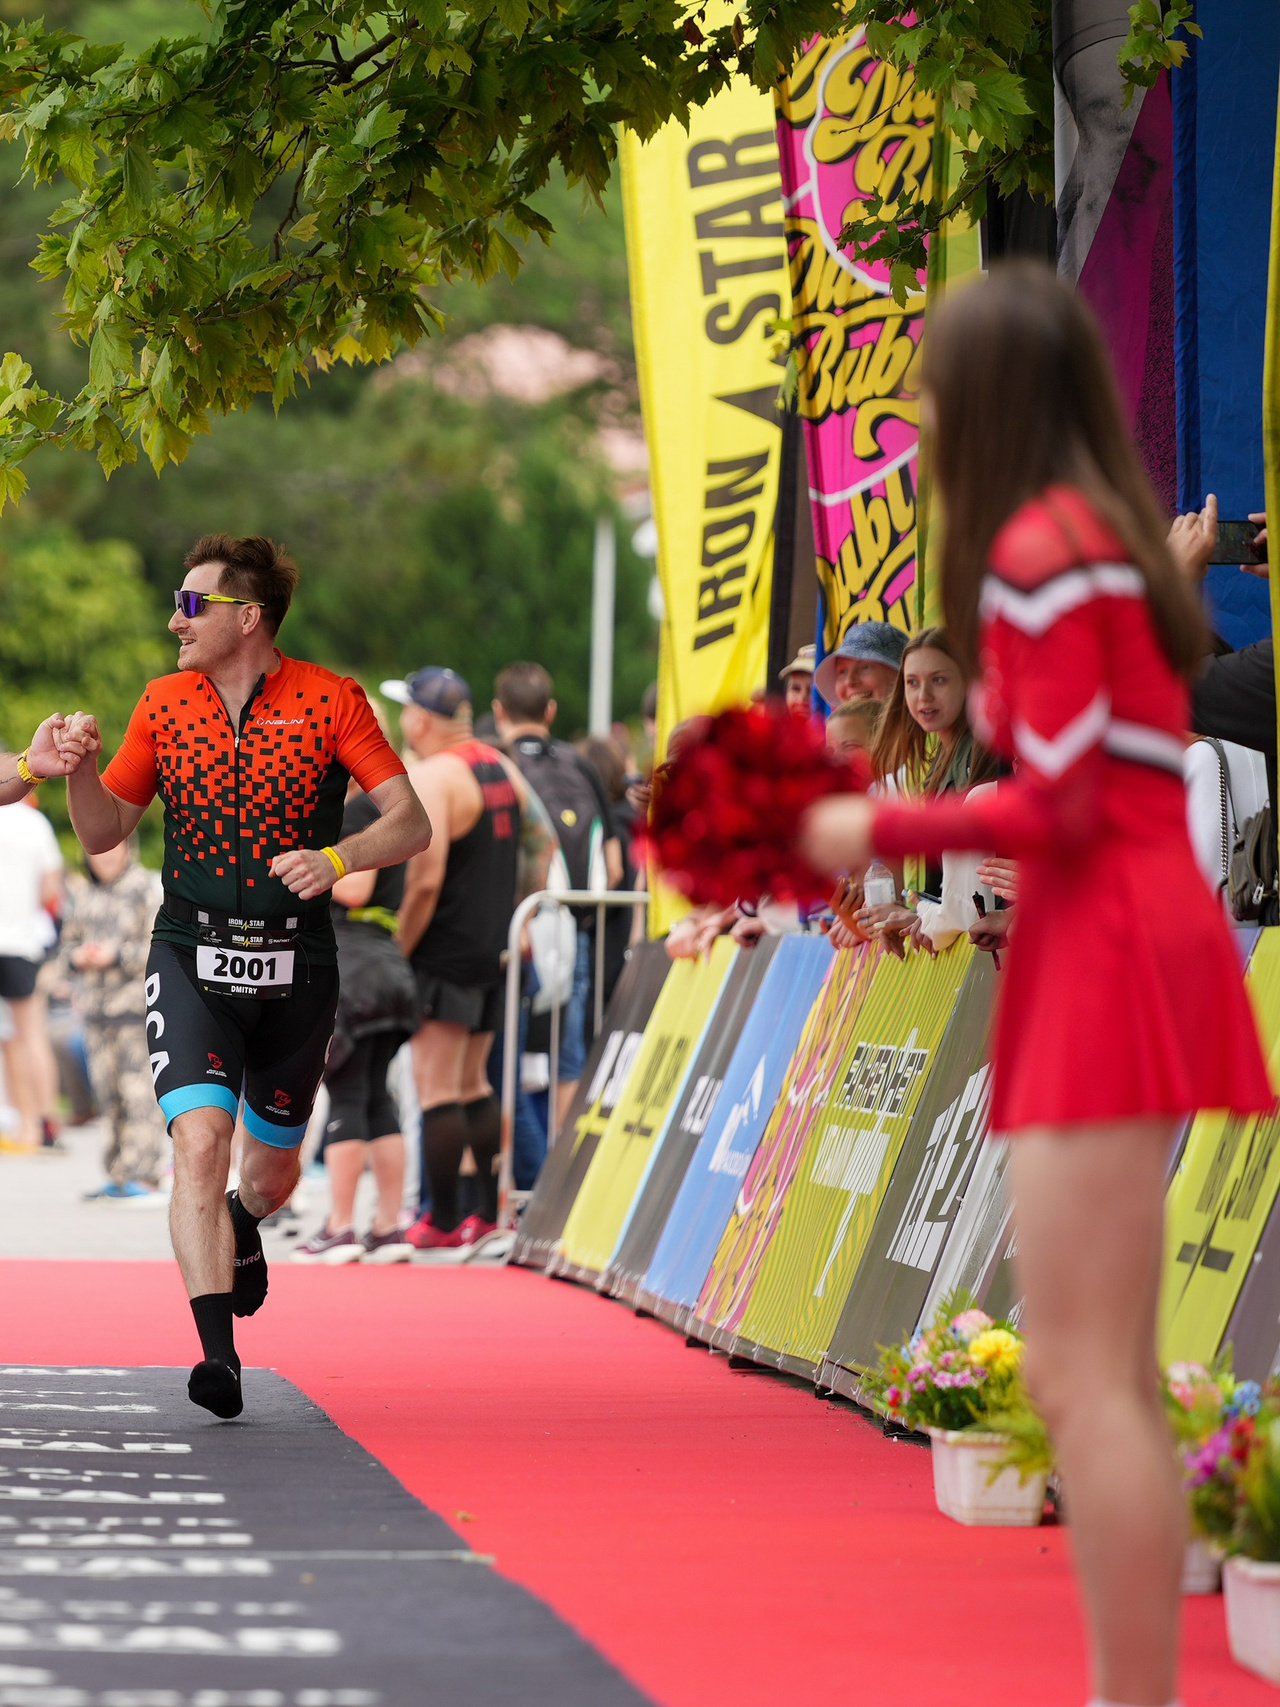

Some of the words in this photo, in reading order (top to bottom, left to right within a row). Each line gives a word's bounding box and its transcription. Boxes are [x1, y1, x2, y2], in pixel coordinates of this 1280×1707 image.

[687, 128, 786, 345] STAR
[693, 448, 770, 652] IRON
[228, 918, 243, 926] IRON
[232, 934, 245, 942] IRON
[213, 953, 277, 981] 2001
[231, 985, 258, 995] DMITRY
[233, 1251, 262, 1267] GIRO
